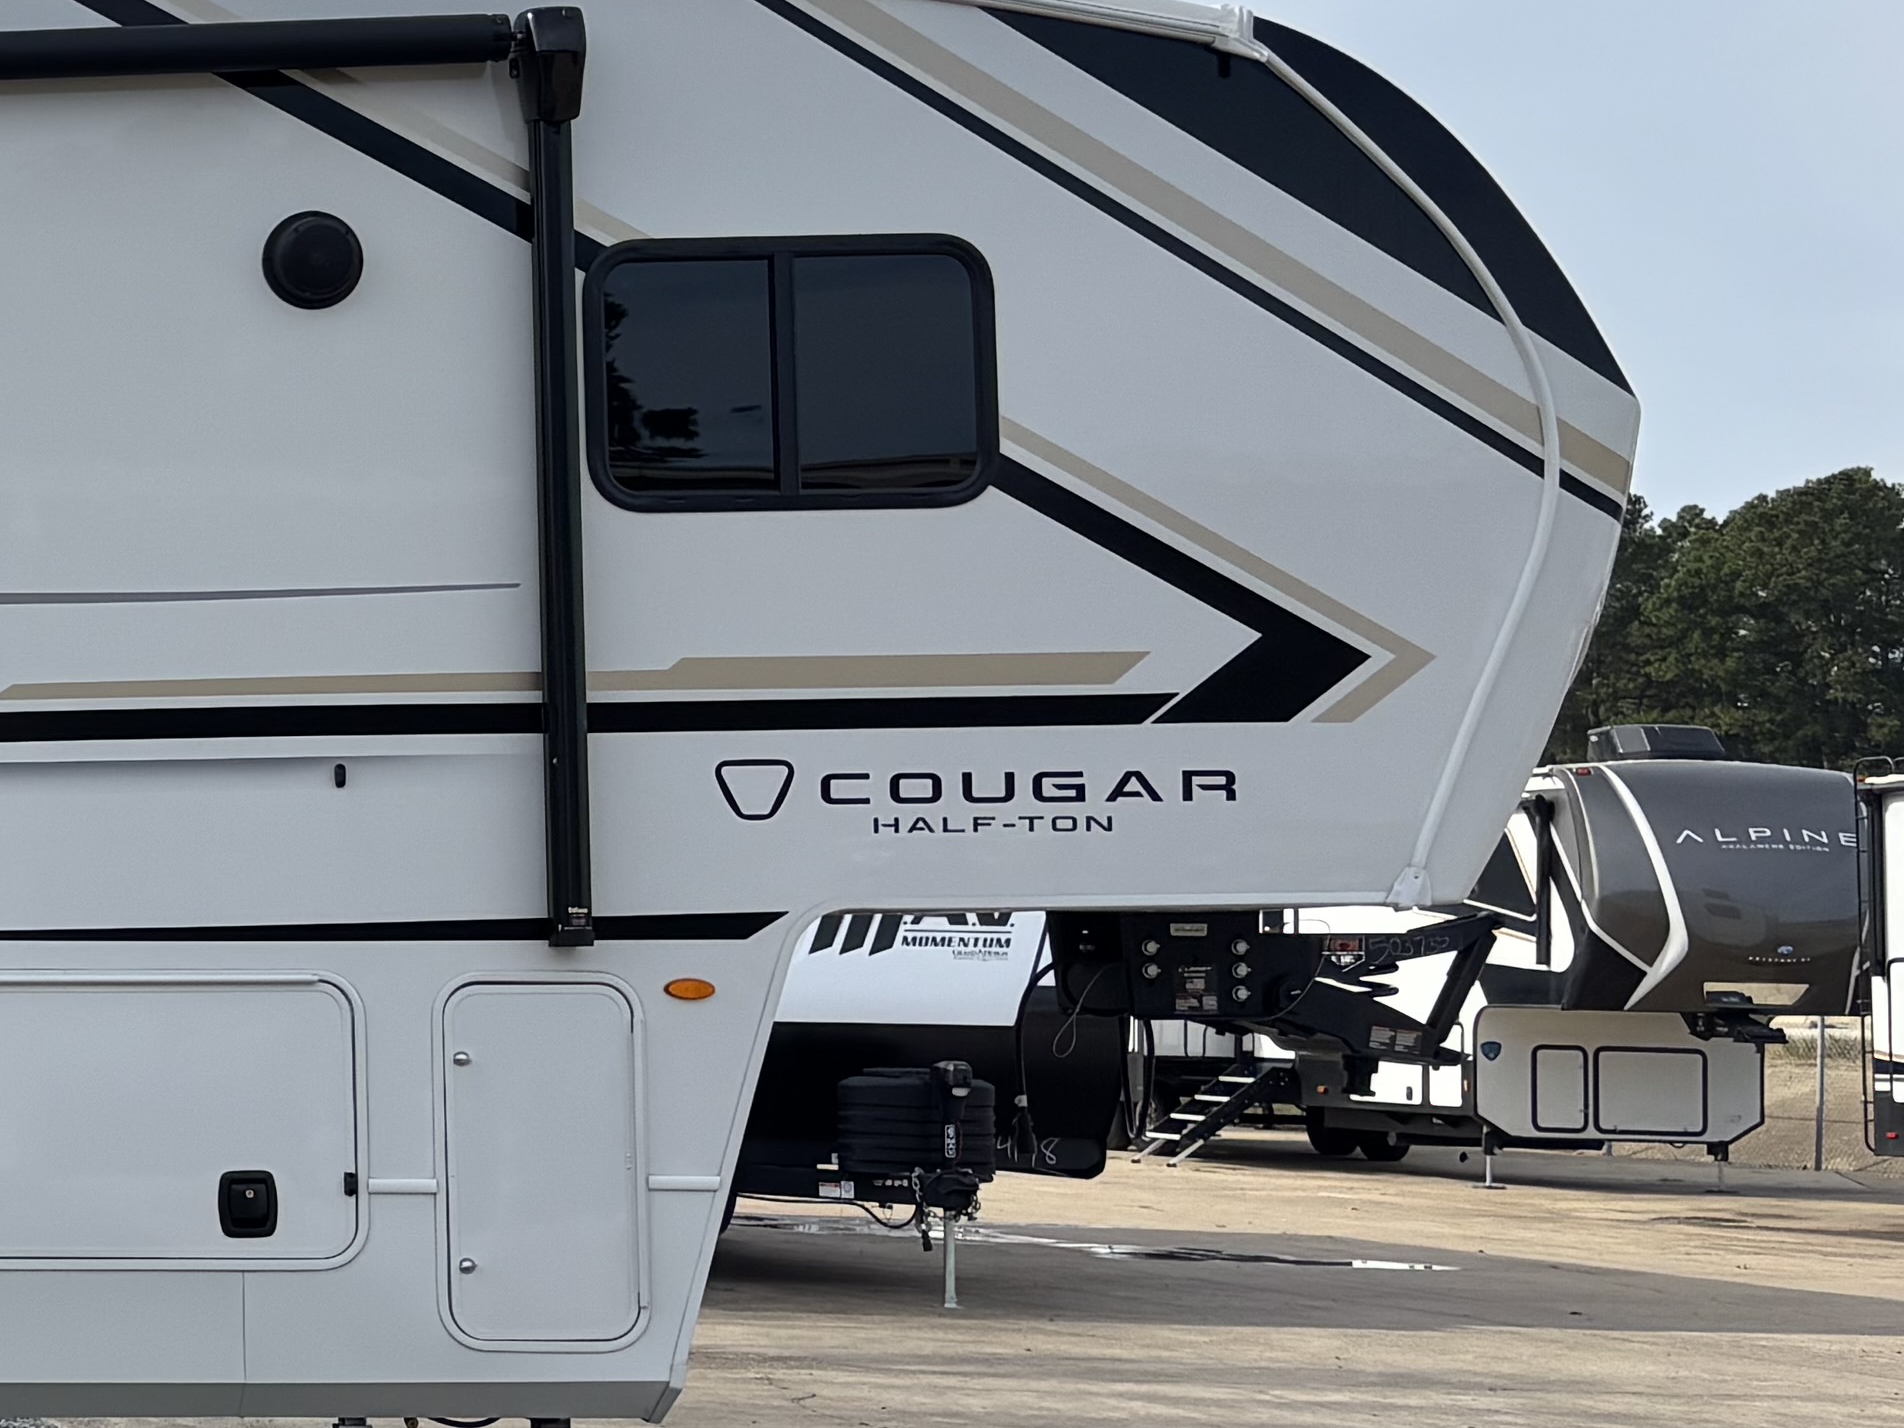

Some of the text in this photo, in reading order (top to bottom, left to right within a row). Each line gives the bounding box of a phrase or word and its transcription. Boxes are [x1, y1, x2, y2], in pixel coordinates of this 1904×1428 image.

[820, 770, 1237, 804] COUGAR
[873, 815, 1115, 835] HALF-TON
[1676, 828, 1857, 847] ALPINE
[901, 935, 1012, 949] MOMENTUM
